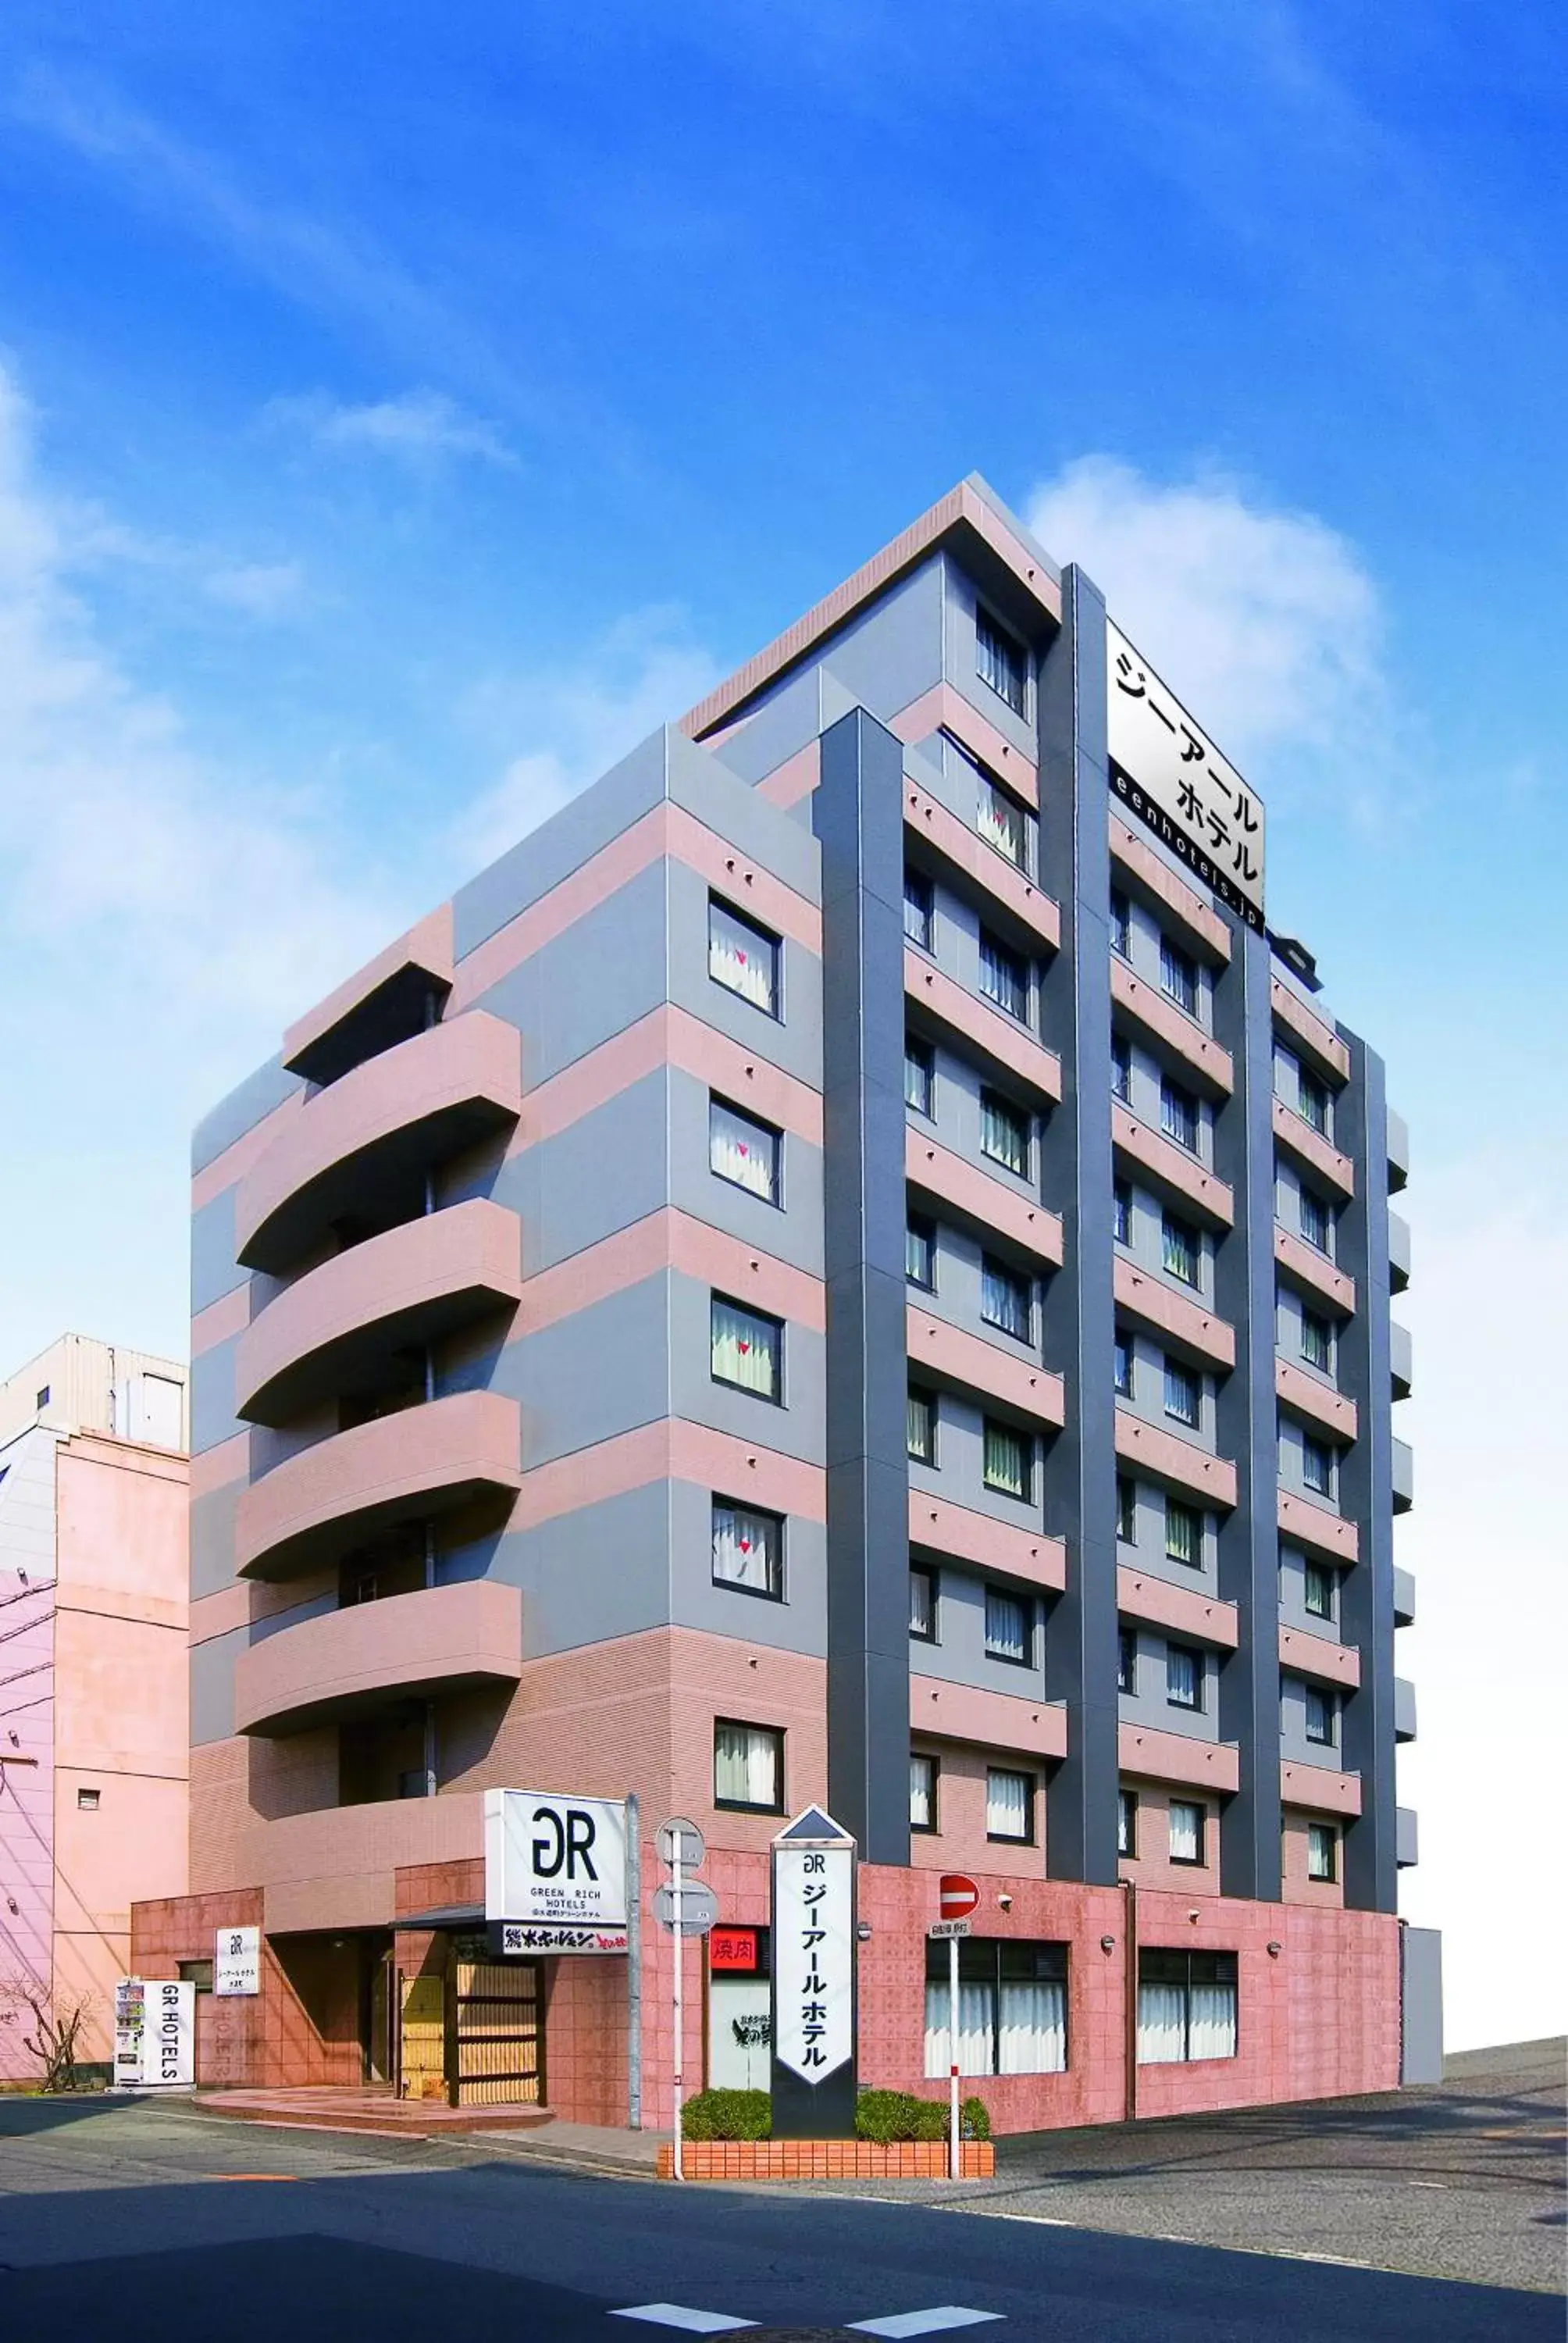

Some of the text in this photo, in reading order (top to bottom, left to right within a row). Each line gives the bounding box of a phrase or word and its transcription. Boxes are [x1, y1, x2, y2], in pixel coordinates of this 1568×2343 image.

[1116, 653, 1258, 832] ジーアール
[1176, 779, 1258, 882] ホテル
[530, 1887, 600, 1899] GREEN RICH
[546, 1899, 586, 1910] HOTELS
[712, 1938, 753, 1961] 焼肉
[162, 1985, 179, 2079] GR HOTELS
